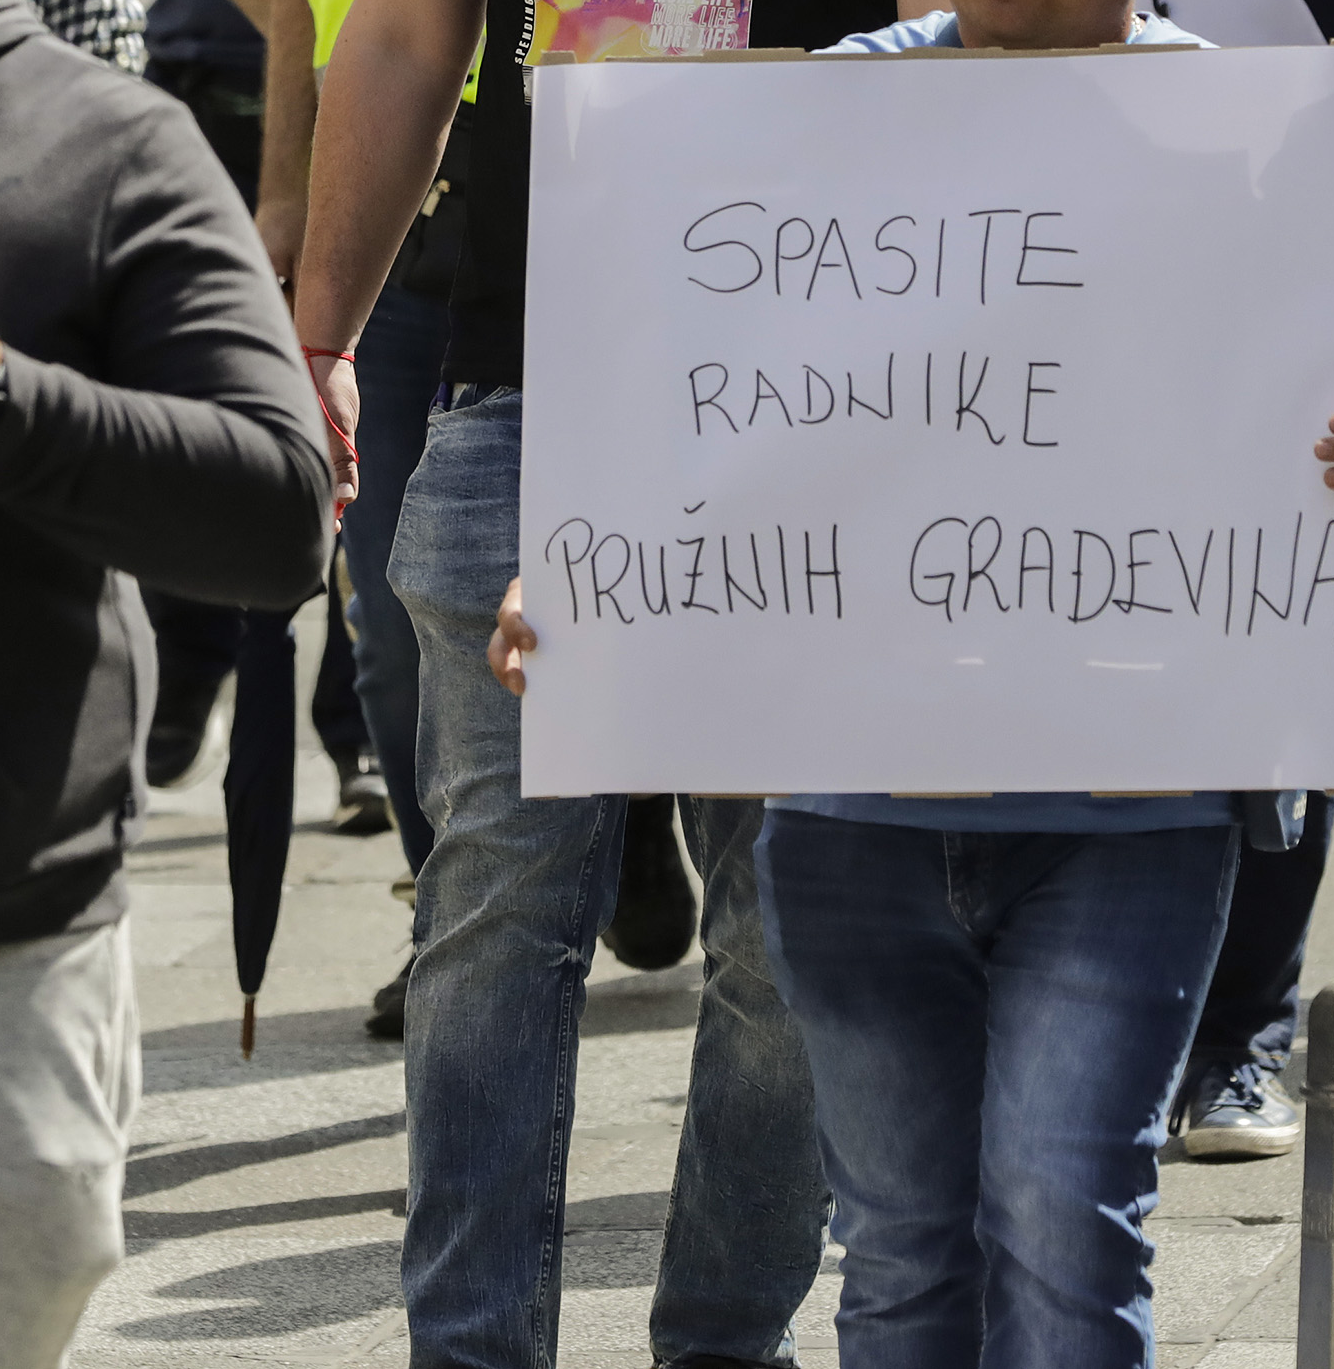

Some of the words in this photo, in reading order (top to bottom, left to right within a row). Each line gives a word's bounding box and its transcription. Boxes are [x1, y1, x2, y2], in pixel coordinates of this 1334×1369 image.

[648, 24, 694, 48] MORE
[697, 27, 733, 50] LIFE
[650, 2, 697, 26] MORE
[698, 5, 737, 29] LIFE
[682, 201, 1085, 306] SPASITE
[687, 350, 1063, 448] RADNIKE
[544, 500, 843, 626] PRUŽNIH
